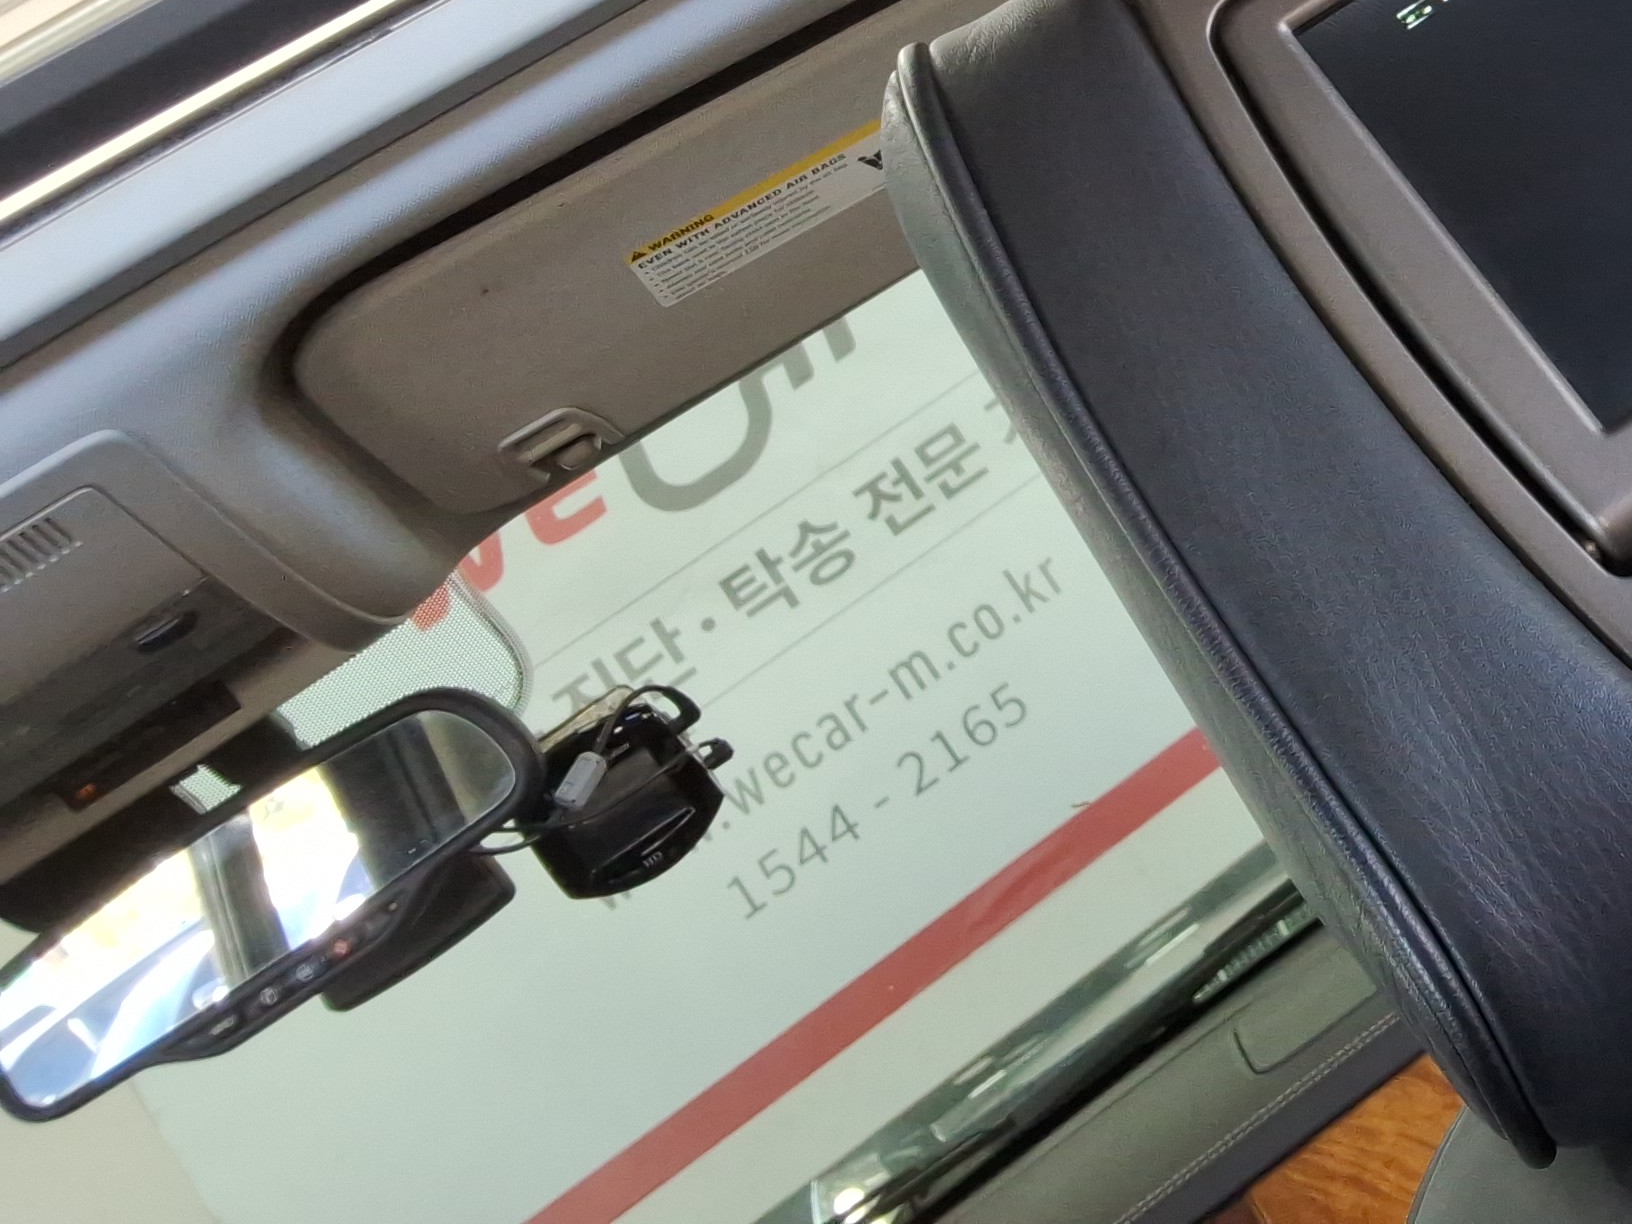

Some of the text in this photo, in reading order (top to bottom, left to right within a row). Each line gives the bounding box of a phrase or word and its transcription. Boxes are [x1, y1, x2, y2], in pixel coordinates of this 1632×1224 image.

[638, 153, 847, 270] EVEN WITH ADVANCED AIR BAGS
[648, 214, 714, 252] WARNING
[854, 422, 989, 536] 전문
